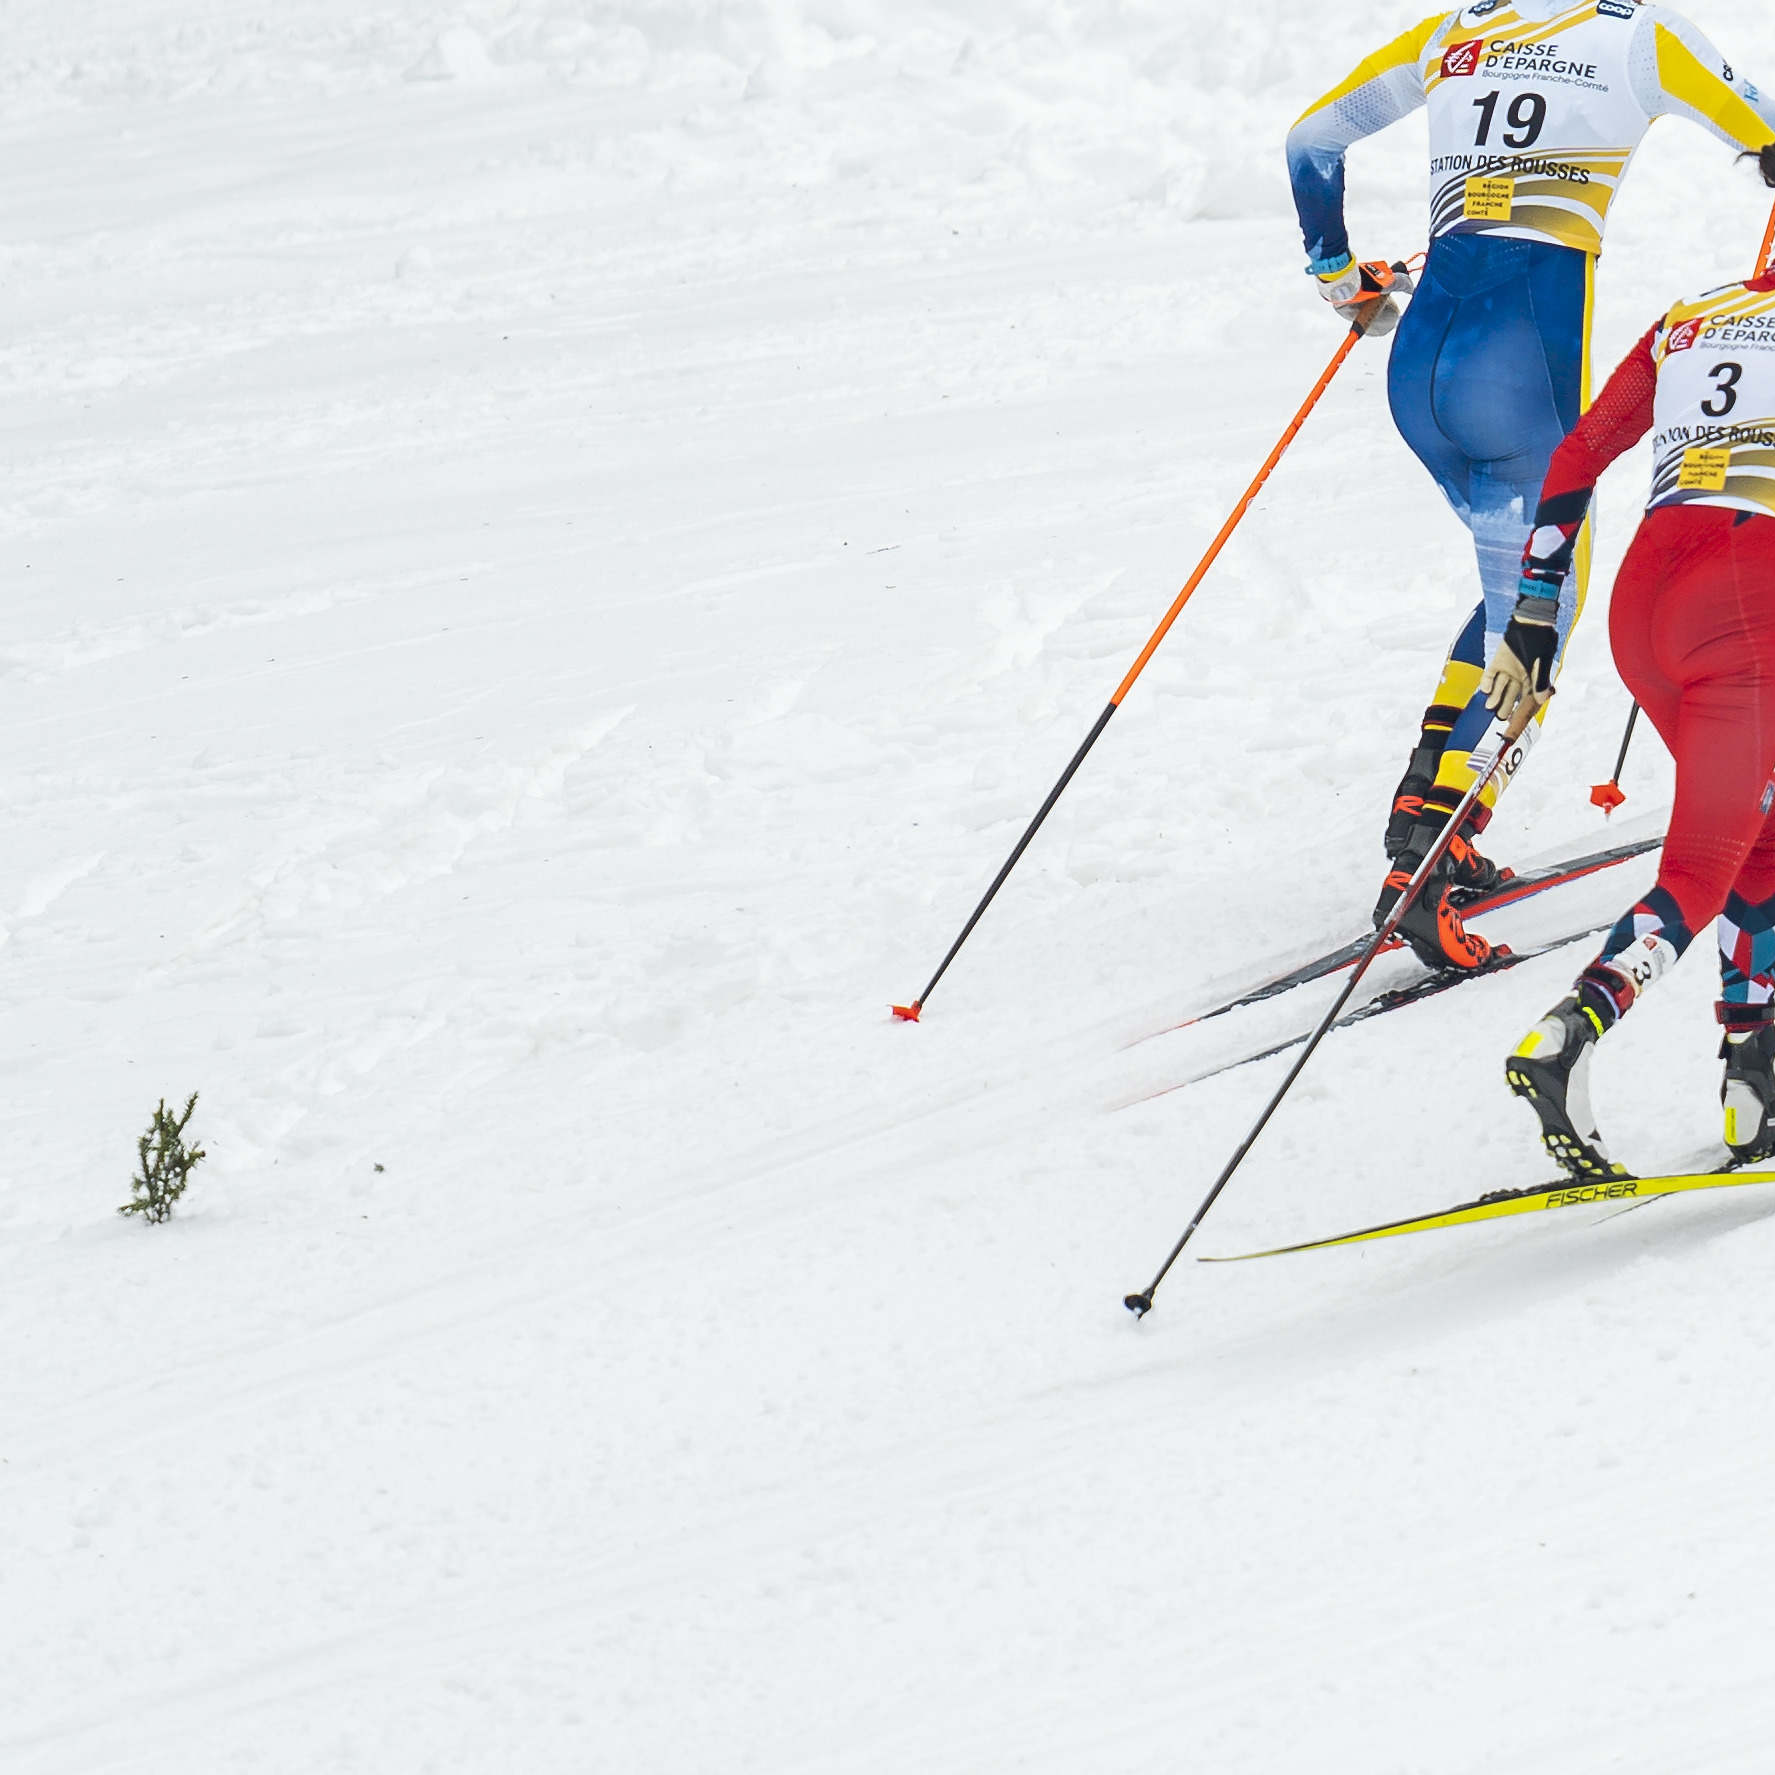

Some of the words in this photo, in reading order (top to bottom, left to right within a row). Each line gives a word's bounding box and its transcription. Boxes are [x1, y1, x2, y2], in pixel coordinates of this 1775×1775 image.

[1599, 1, 1633, 17] coop
[1490, 39, 1559, 57] CAISSE
[1485, 55, 1597, 79] D'EPARGNE
[1481, 70, 1530, 82] Bourgogne
[1532, 72, 1609, 93] Franche-Comté
[1471, 90, 1547, 149] 19
[1430, 154, 1473, 175] STATION
[1477, 155, 1511, 171] DES
[1511, 156, 1591, 185] ROUSSES
[1700, 362, 1743, 417] 3
[1696, 425, 1728, 441] DES
[1545, 1182, 1638, 1209] FISCHER
